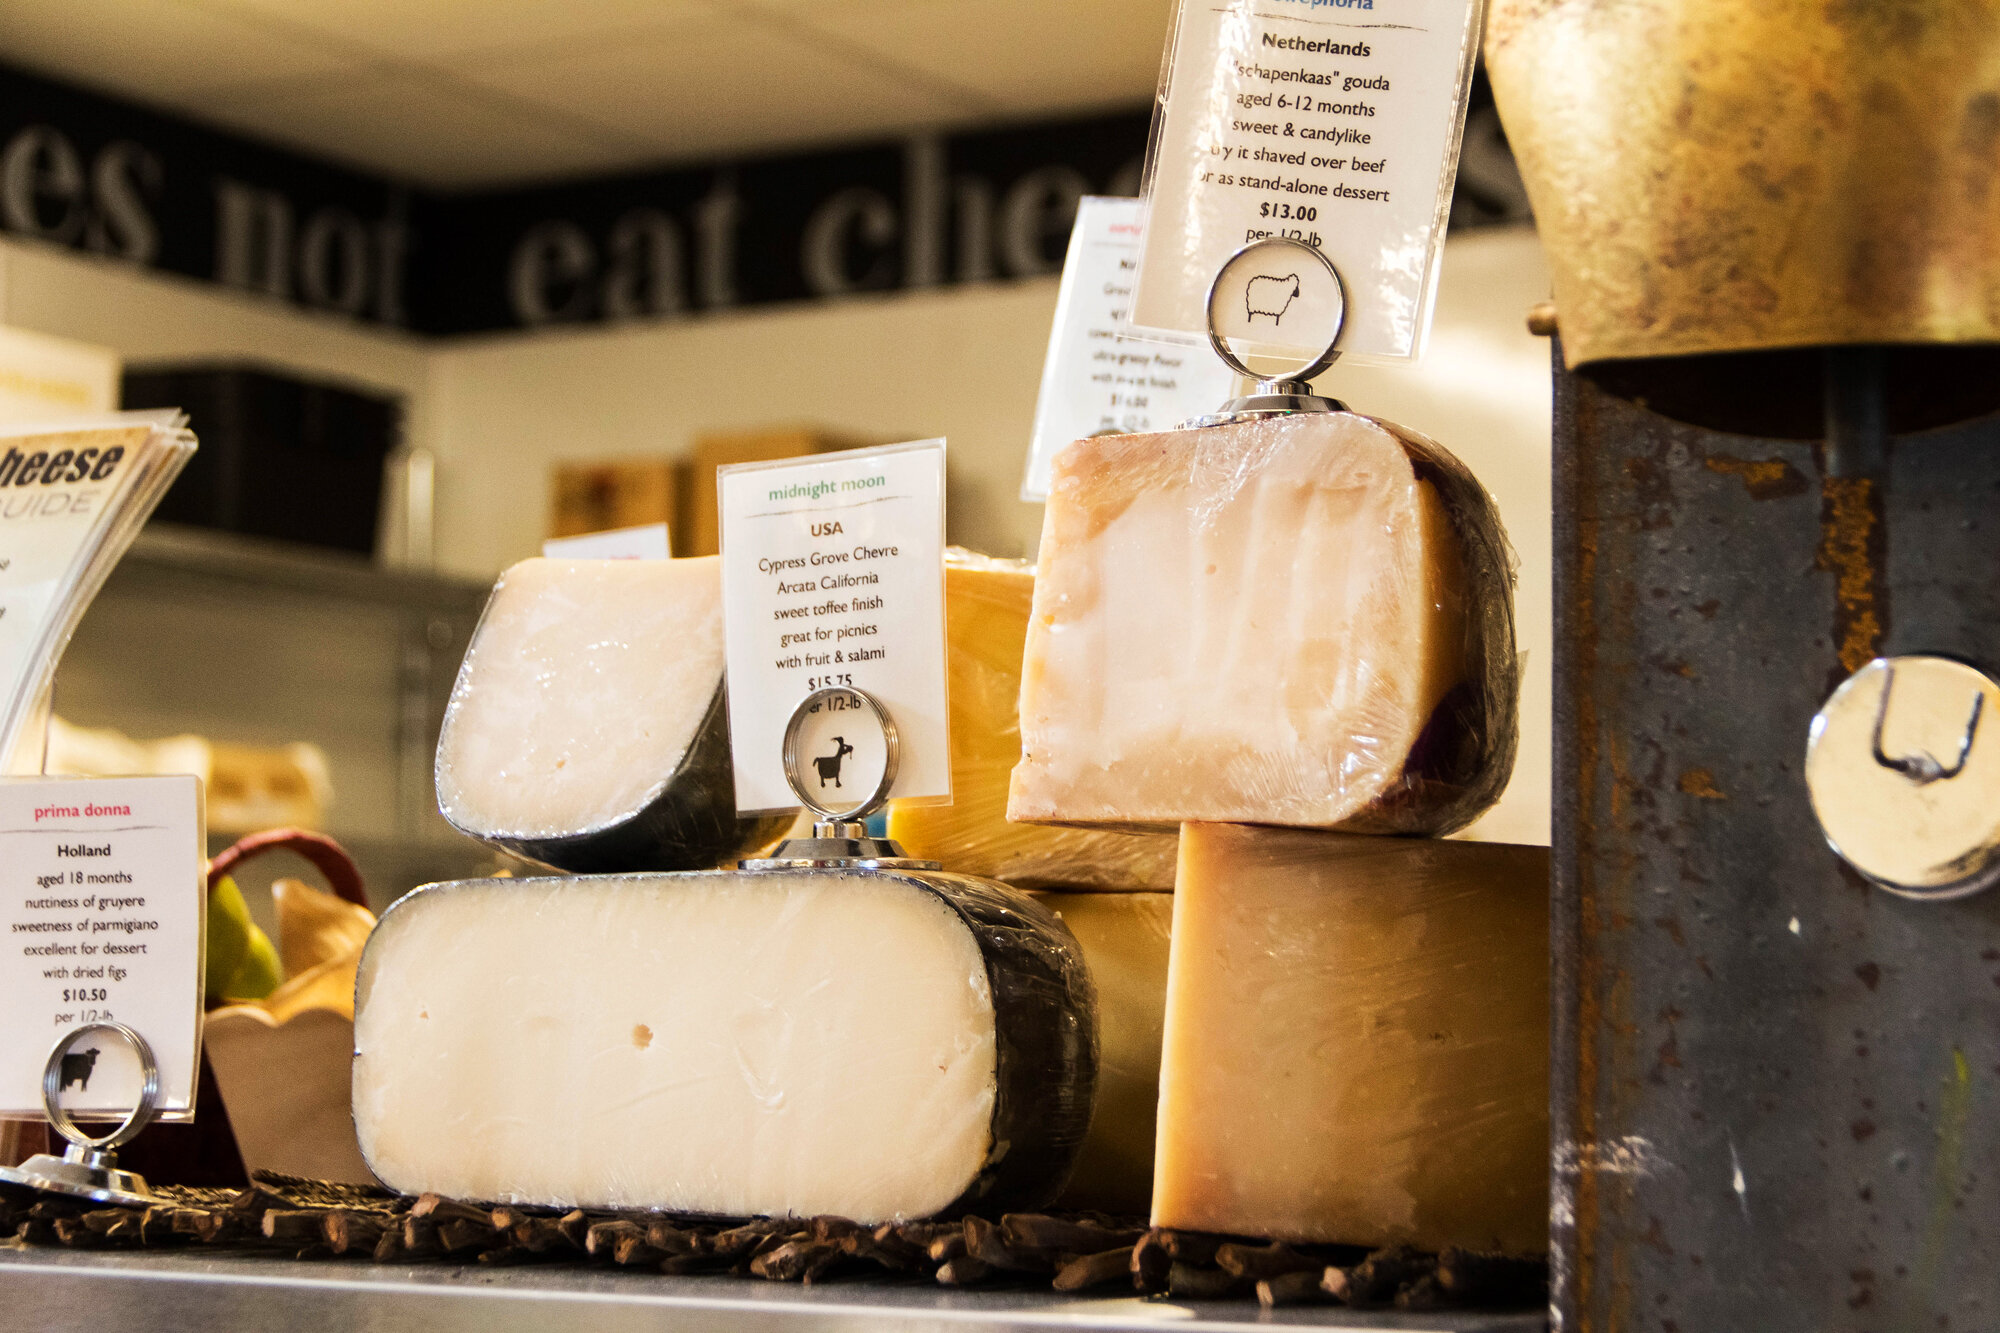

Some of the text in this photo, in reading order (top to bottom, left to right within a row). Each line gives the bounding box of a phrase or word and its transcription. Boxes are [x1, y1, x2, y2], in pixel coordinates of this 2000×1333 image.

[1272, 0, 1374, 10] poria
[1262, 32, 1371, 57] Netherlands
[1233, 60, 1390, 91] "schapenkaas" gouda
[1236, 92, 1375, 117] aged 6-12 months
[1232, 119, 1371, 146] sweet & candylike
[1237, 145, 1249, 159] it
[1253, 147, 1305, 166] shaved
[1311, 156, 1347, 170] over
[1352, 156, 1387, 173] beef
[1218, 173, 1233, 185] as
[1239, 176, 1328, 196] stand-alone
[1333, 183, 1390, 202] dessert
[1259, 202, 1318, 222] $13.00
[3, 120, 166, 266] es
[210, 174, 410, 328] not
[508, 168, 746, 327] eat
[798, 130, 1145, 296] che
[1246, 228, 1322, 248] per 1/2-lb
[0, 445, 126, 487] heese
[769, 475, 886, 501] midnight moon
[0, 489, 101, 519] UIDE
[811, 521, 844, 537] USA
[758, 546, 899, 575] Cypress Grove Chevre
[777, 571, 879, 595] Arcata California
[774, 595, 884, 620] sweet toffee finish
[780, 623, 878, 648] great for picnics
[775, 645, 886, 669] with fruit & salami
[808, 674, 853, 691] $1575
[808, 695, 861, 713] er 1/2-lb
[34, 803, 131, 822] prima donna
[57, 843, 111, 857] Holland
[36, 870, 133, 889] aged 18 months
[25, 894, 145, 911] nuttiness of gruyere
[12, 918, 159, 935] sweetness of parmigiano
[23, 941, 147, 956] excellent for dessert
[43, 965, 127, 982] with dried figs
[63, 988, 107, 1002] $10.50
[54, 1009, 114, 1027] per 1/2-lb
